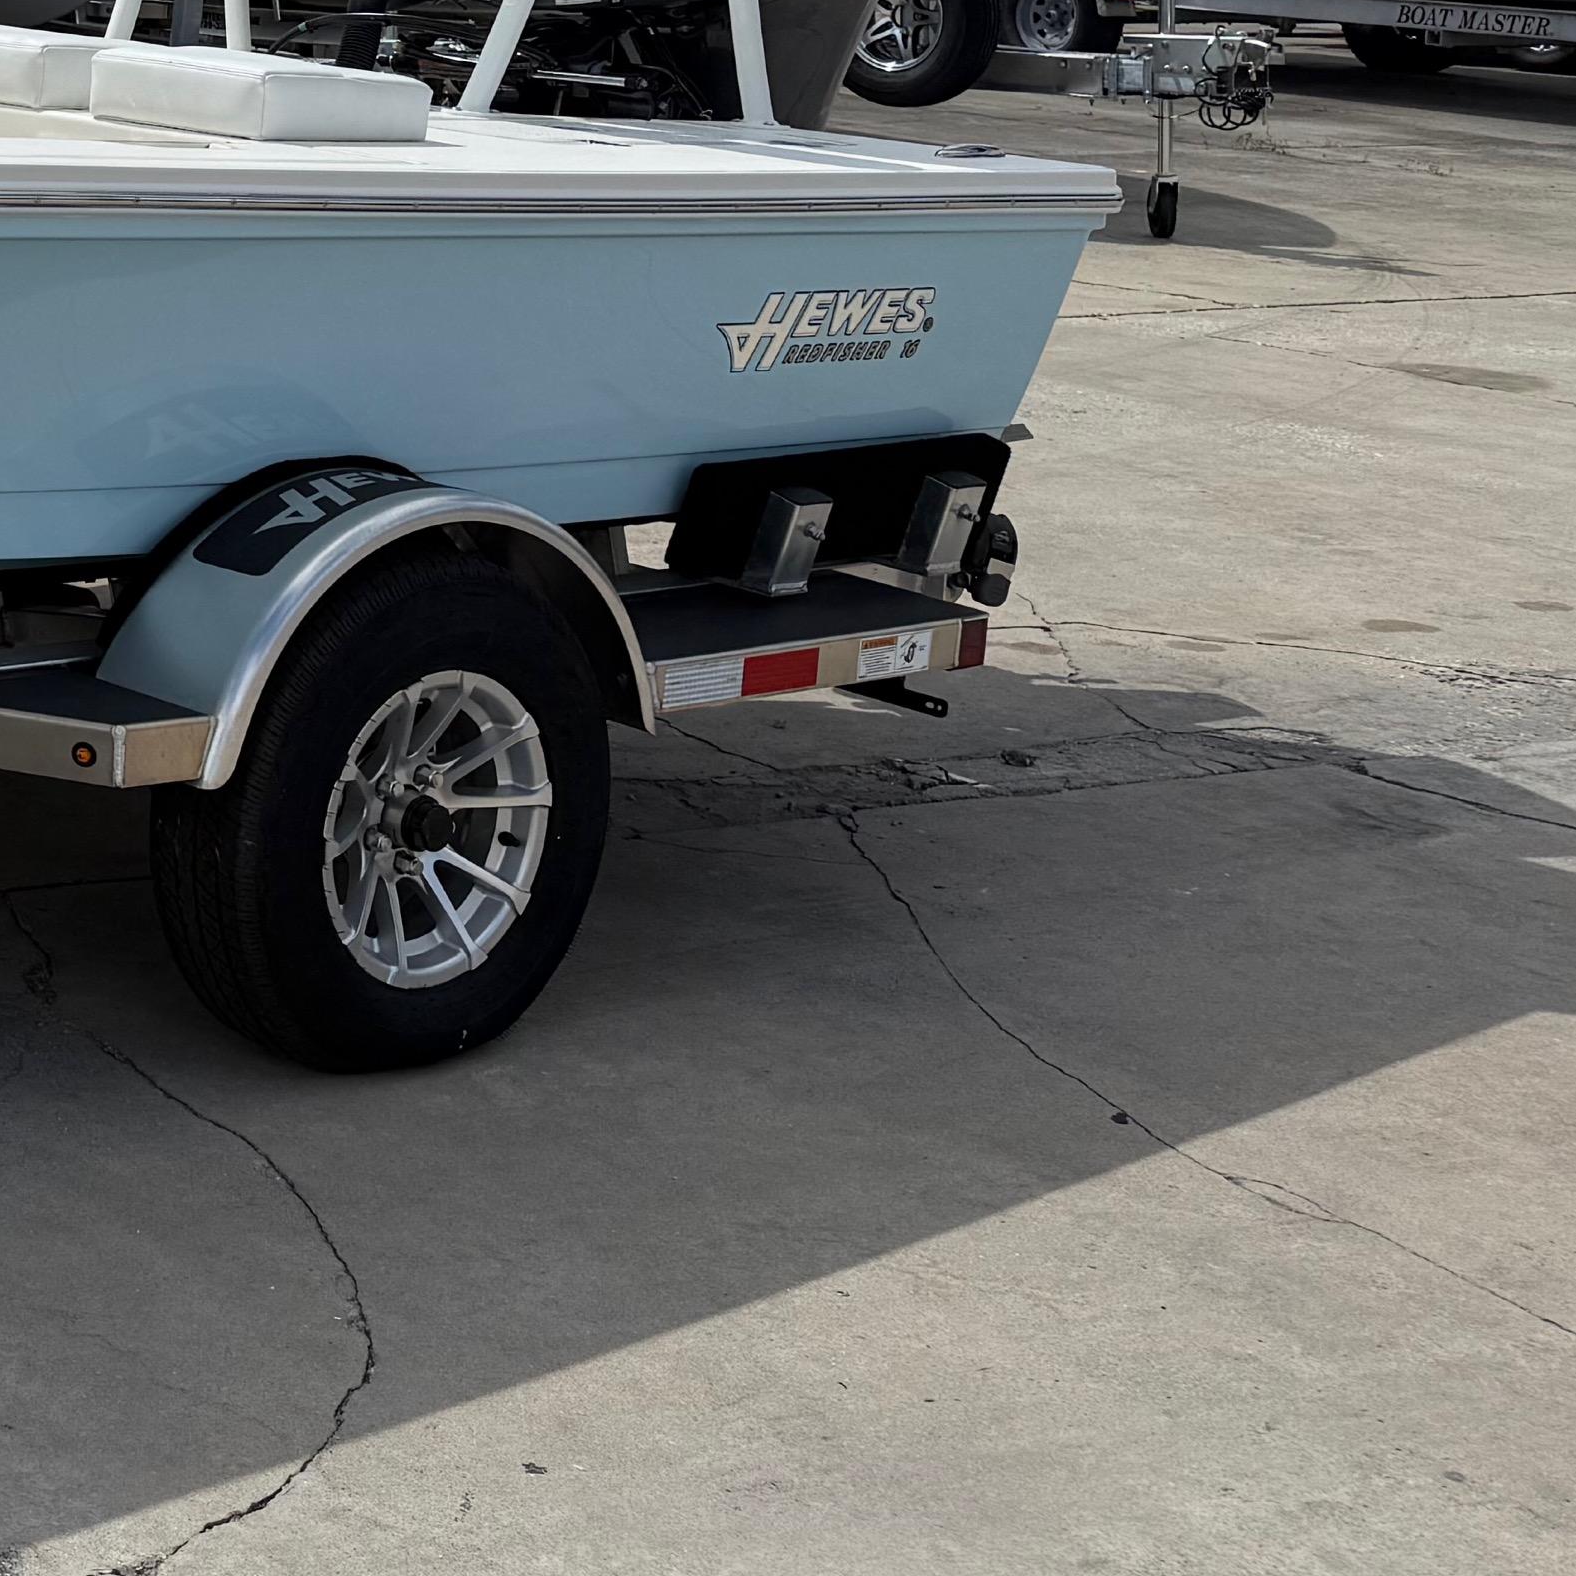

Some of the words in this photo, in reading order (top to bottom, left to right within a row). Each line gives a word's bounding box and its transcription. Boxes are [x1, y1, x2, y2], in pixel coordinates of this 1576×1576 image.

[1397, 5, 1453, 27] BOAT
[1458, 10, 1551, 36] MASTER
[716, 287, 936, 373] HEWES
[782, 340, 891, 364] REDFISHER
[900, 339, 921, 359] 16
[253, 472, 418, 535] HEW
